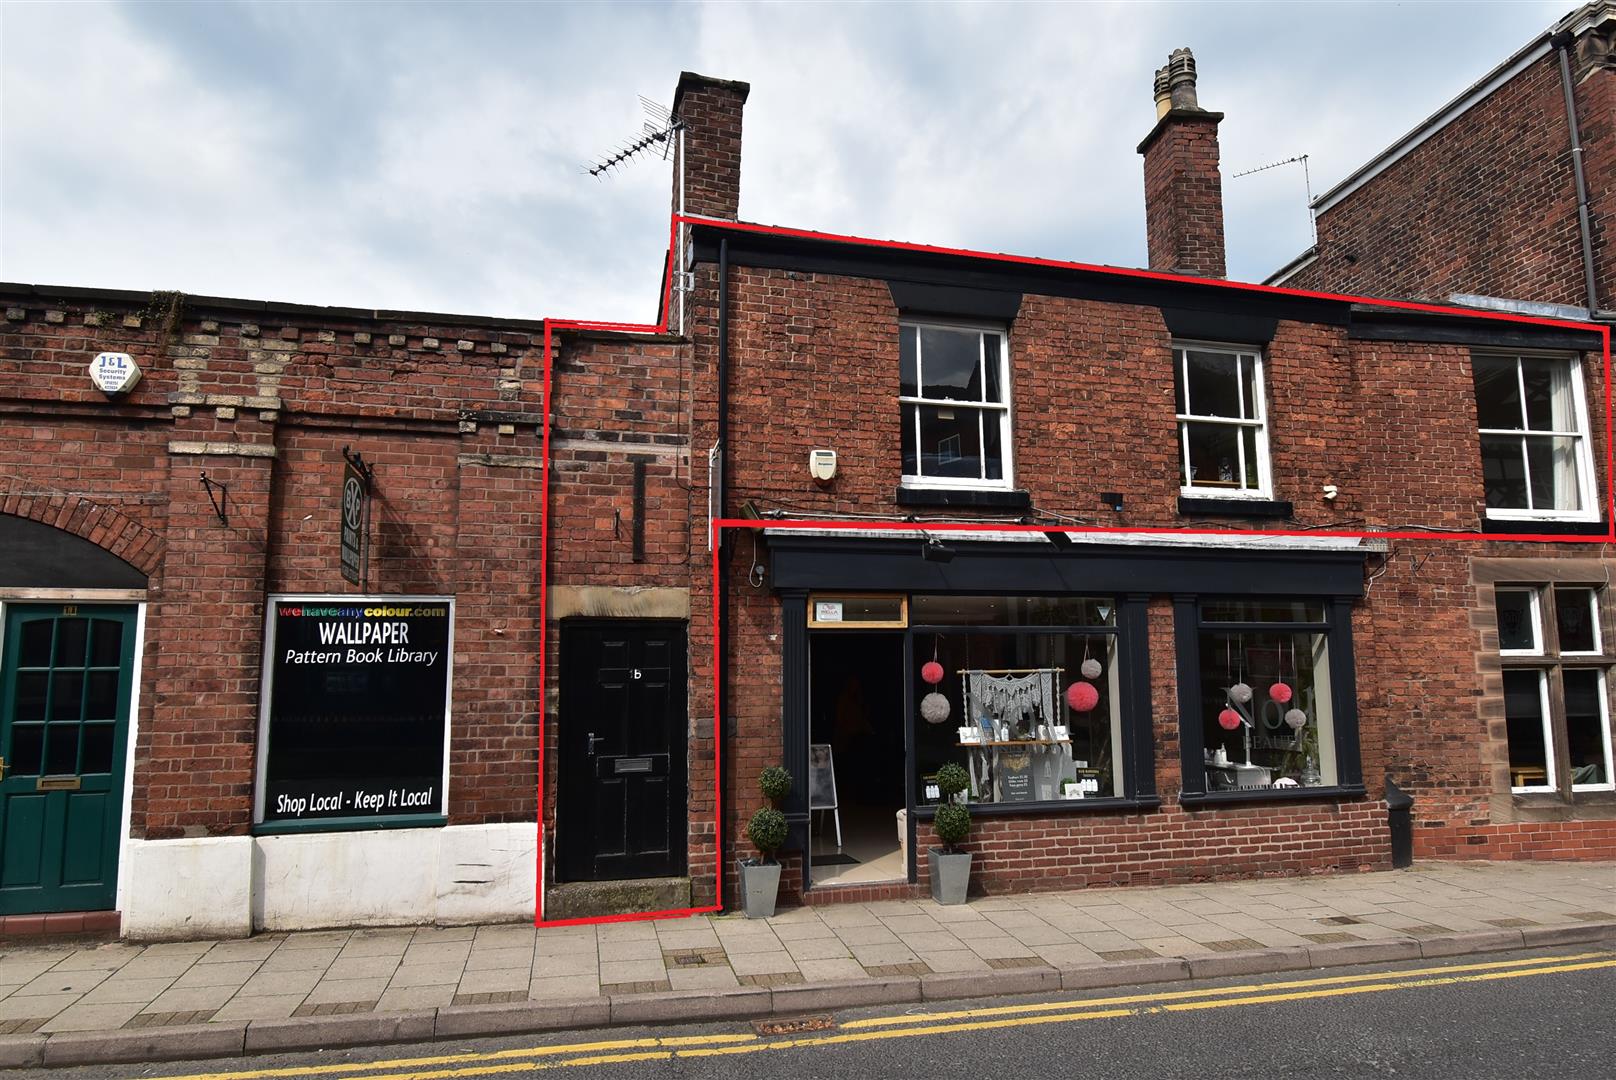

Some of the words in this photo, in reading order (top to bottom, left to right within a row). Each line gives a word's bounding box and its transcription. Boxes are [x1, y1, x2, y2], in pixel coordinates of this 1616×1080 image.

[278, 605, 446, 619] wehaveanycolour.com
[318, 621, 409, 645] WALLPAPER
[285, 649, 341, 664] Pattern
[346, 648, 384, 663] Book
[387, 647, 438, 667] Library
[276, 794, 306, 816] Shop
[309, 791, 343, 812] Local
[354, 790, 385, 812] Keep
[387, 789, 398, 808] It
[401, 786, 433, 806] Local
